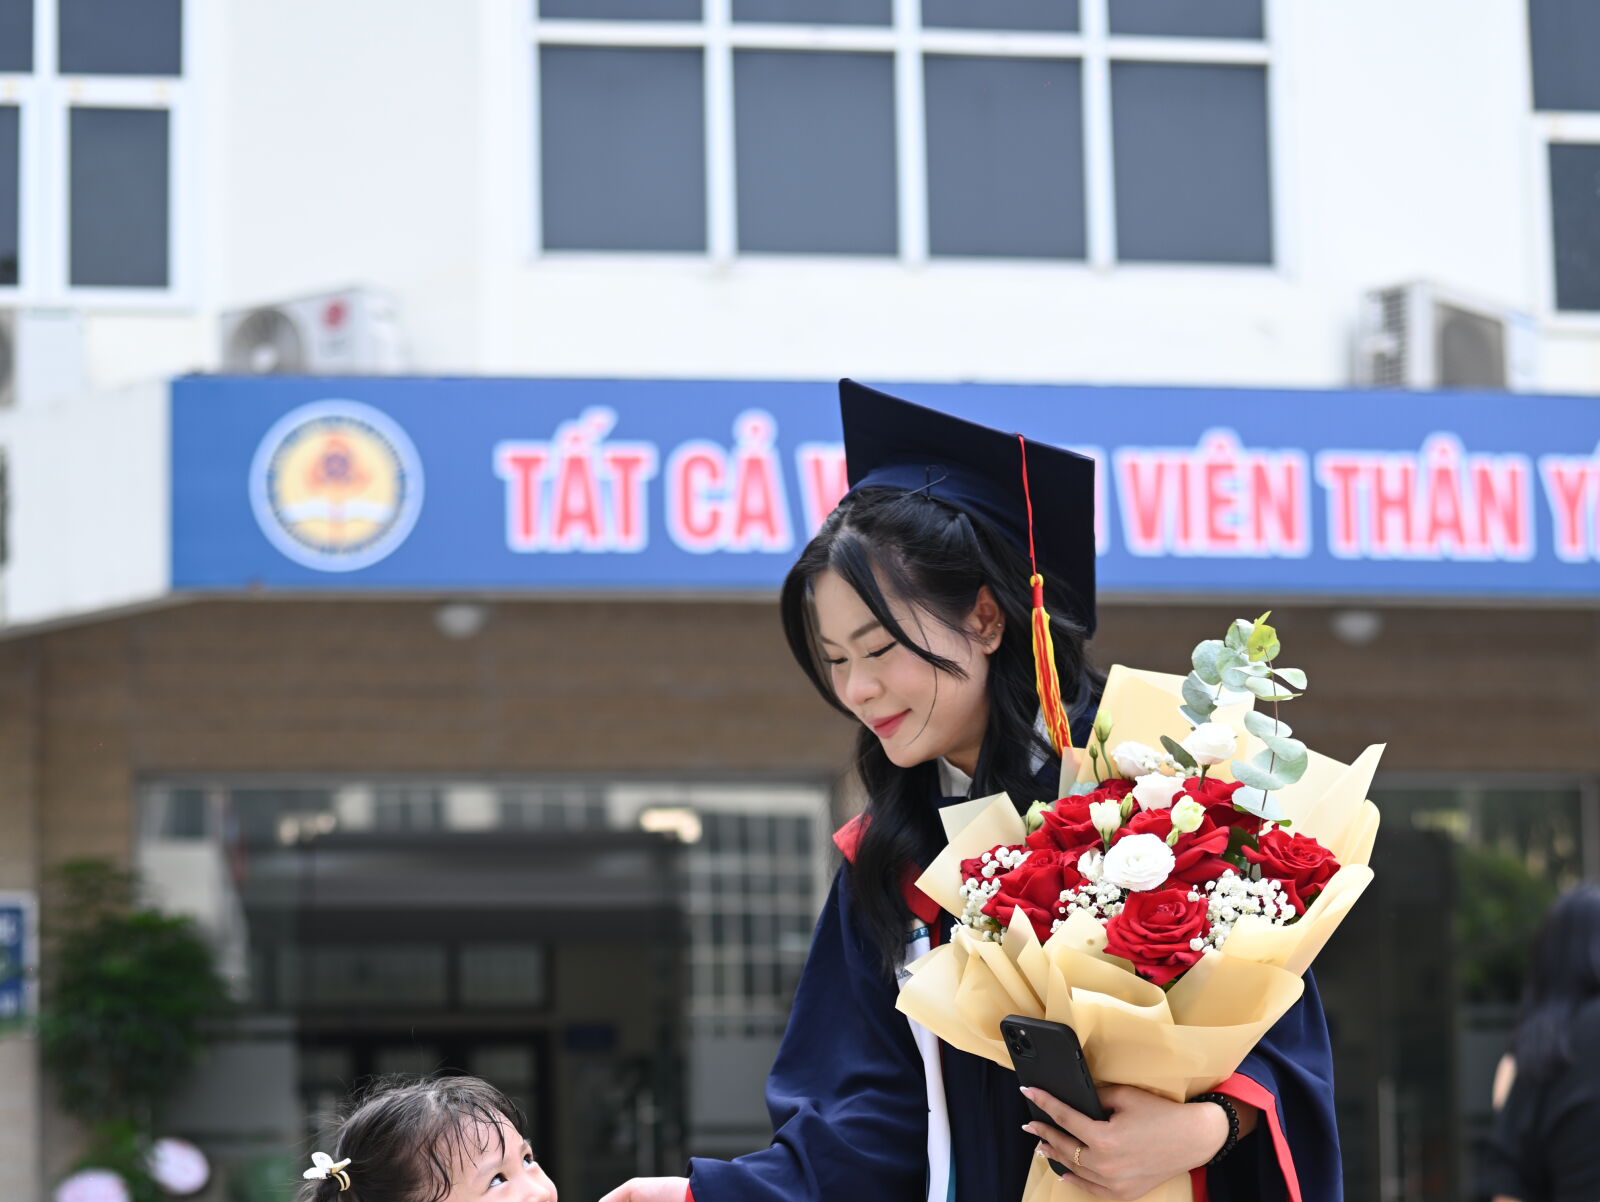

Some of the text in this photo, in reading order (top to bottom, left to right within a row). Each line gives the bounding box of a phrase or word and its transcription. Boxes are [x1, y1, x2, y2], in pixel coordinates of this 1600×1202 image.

[498, 408, 656, 551] TẤT
[668, 411, 793, 551] CẢ
[1116, 431, 1308, 556] VIÊN
[1317, 435, 1534, 560] THÂN
[1540, 446, 1600, 562] Y
